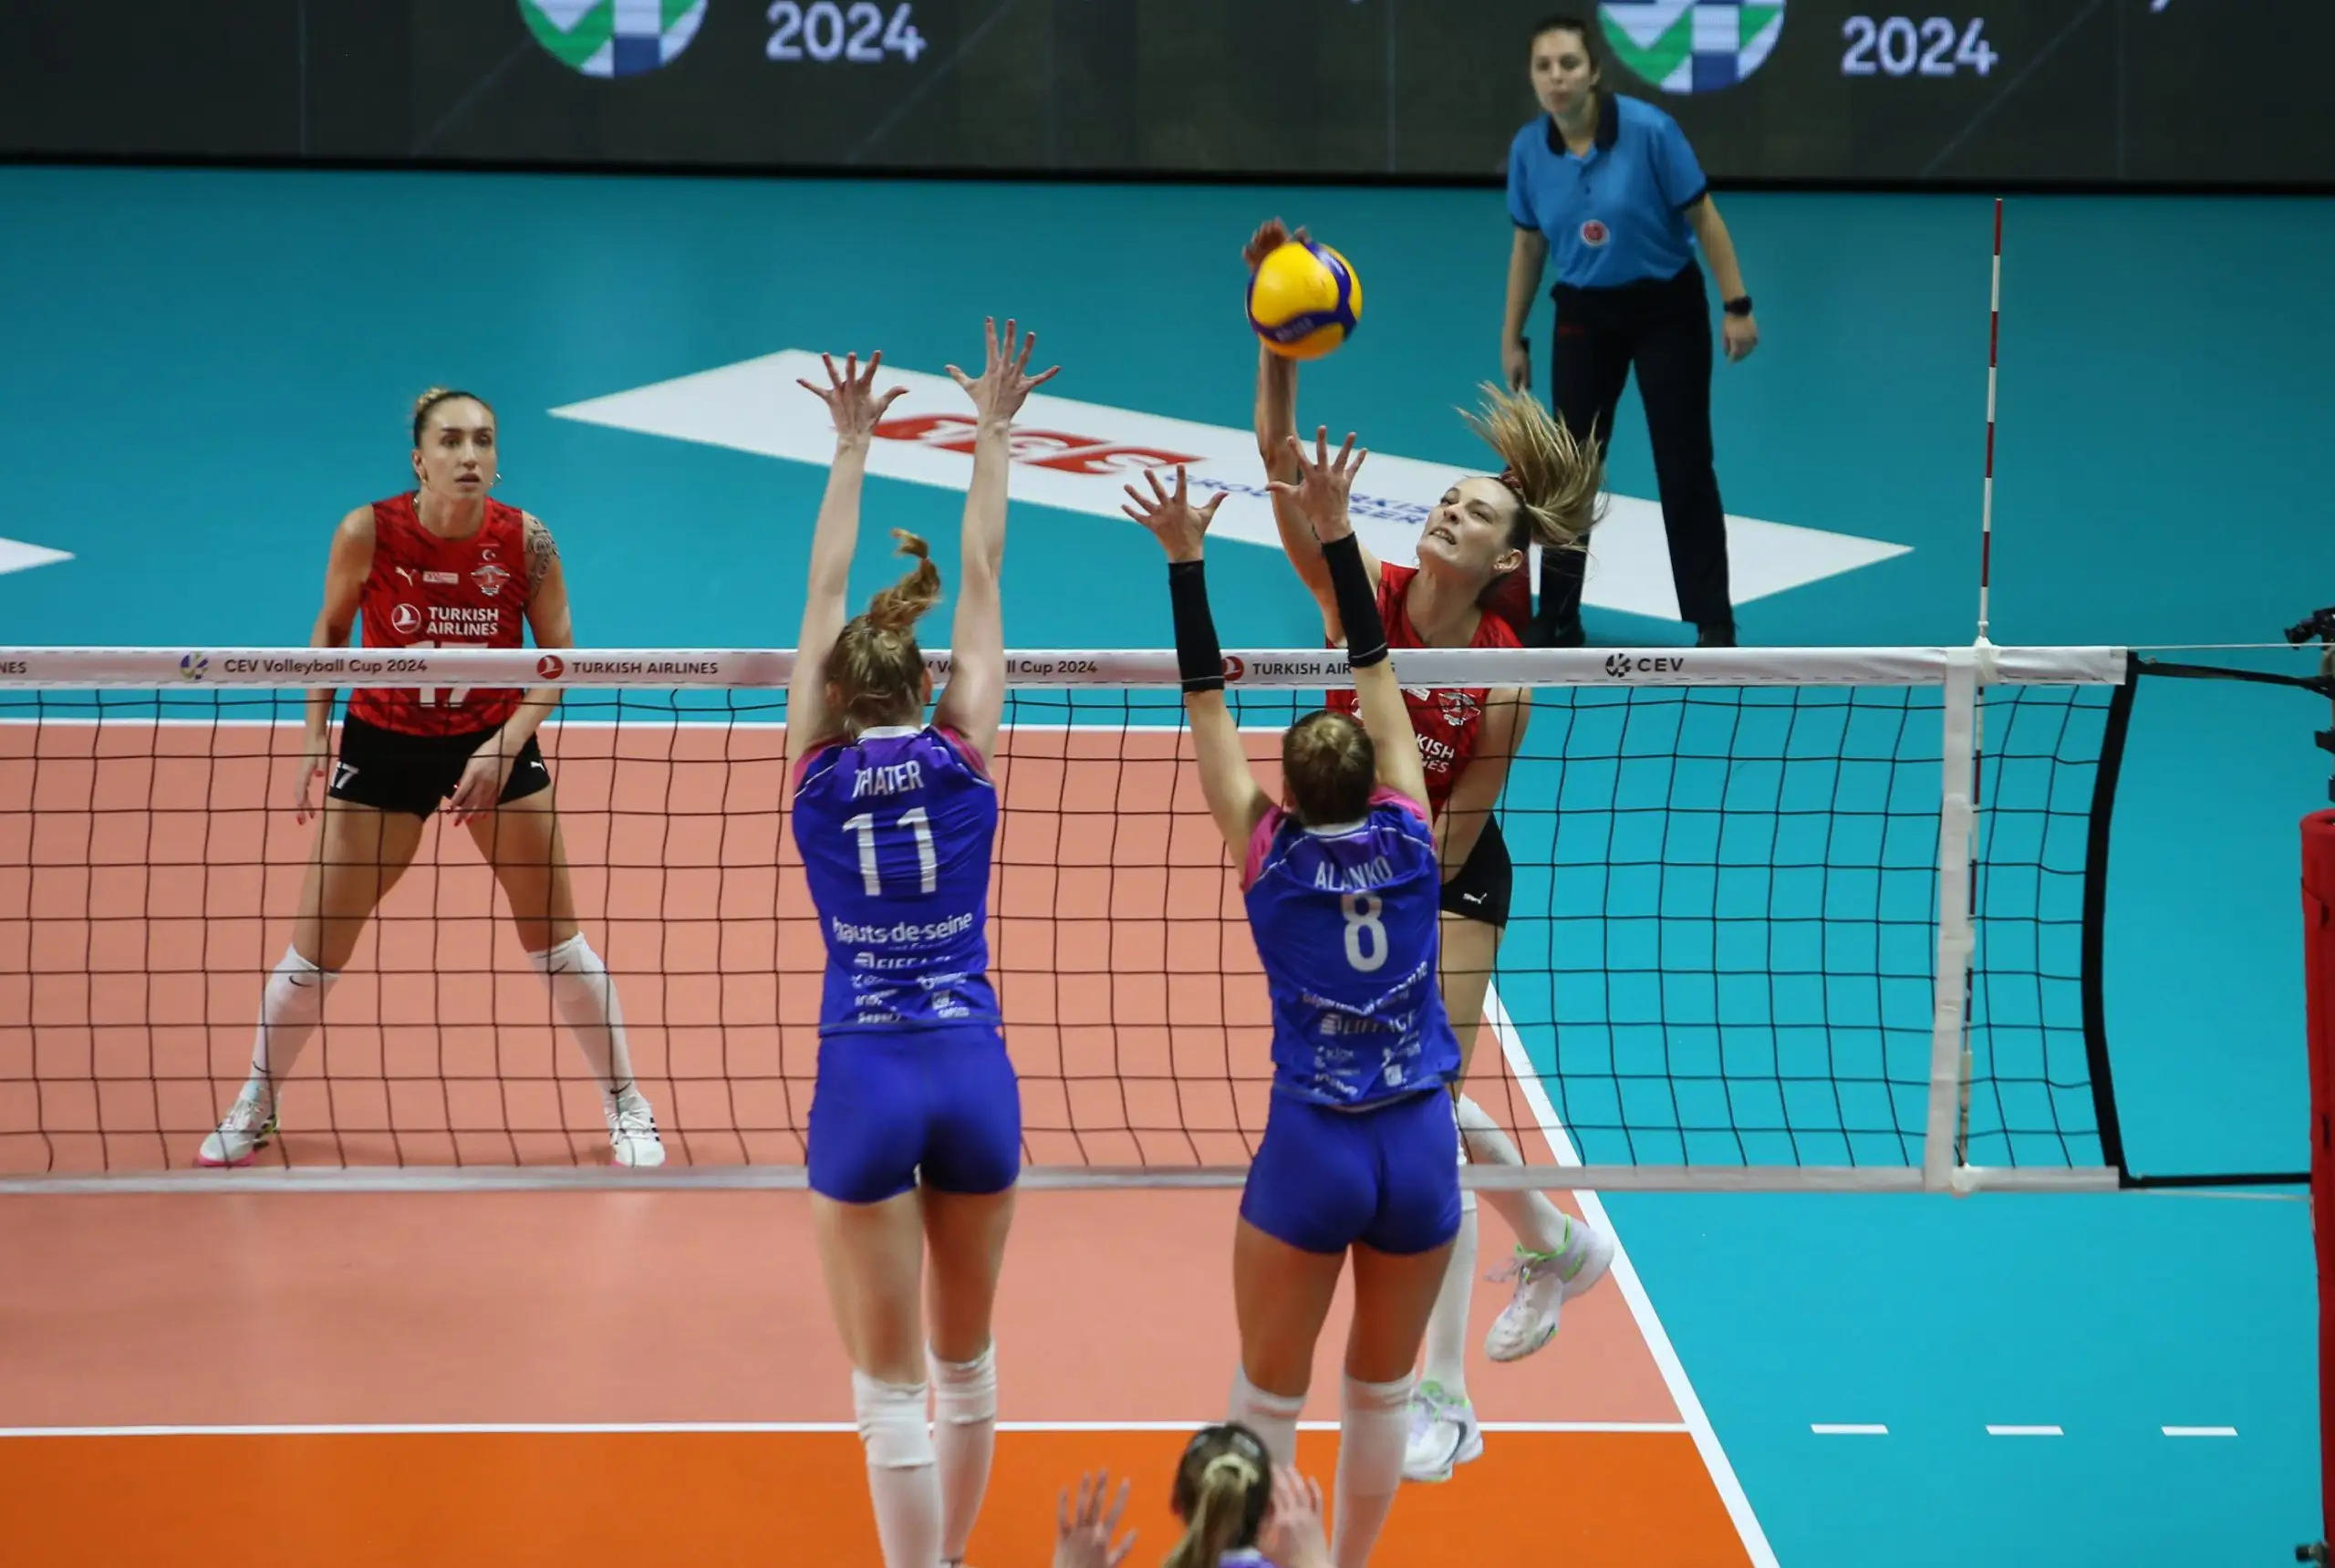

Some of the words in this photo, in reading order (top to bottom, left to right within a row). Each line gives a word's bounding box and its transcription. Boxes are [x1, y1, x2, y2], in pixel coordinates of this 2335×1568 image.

[766, 1, 928, 64] 2024
[1842, 16, 1998, 77] 2024
[427, 606, 499, 622] TURKISH
[426, 622, 499, 637] AIRLINES
[0, 661, 27, 675] NES
[224, 659, 258, 673] CEV
[262, 659, 345, 677] Volleyball
[348, 659, 383, 675] Cup
[387, 659, 428, 673] 2024
[572, 662, 642, 675] TURKISH
[646, 662, 719, 675] AIRLINES
[1021, 660, 1053, 677] Cup
[1057, 660, 1098, 674] 2024
[1252, 663, 1321, 675] TURKISH
[1637, 658, 1684, 672] CEV
[1416, 732, 1456, 759] KISH
[850, 760, 925, 802] THATER
[842, 806, 938, 897] 11
[1313, 856, 1393, 891] ALANKO
[1341, 890, 1388, 973] 8
